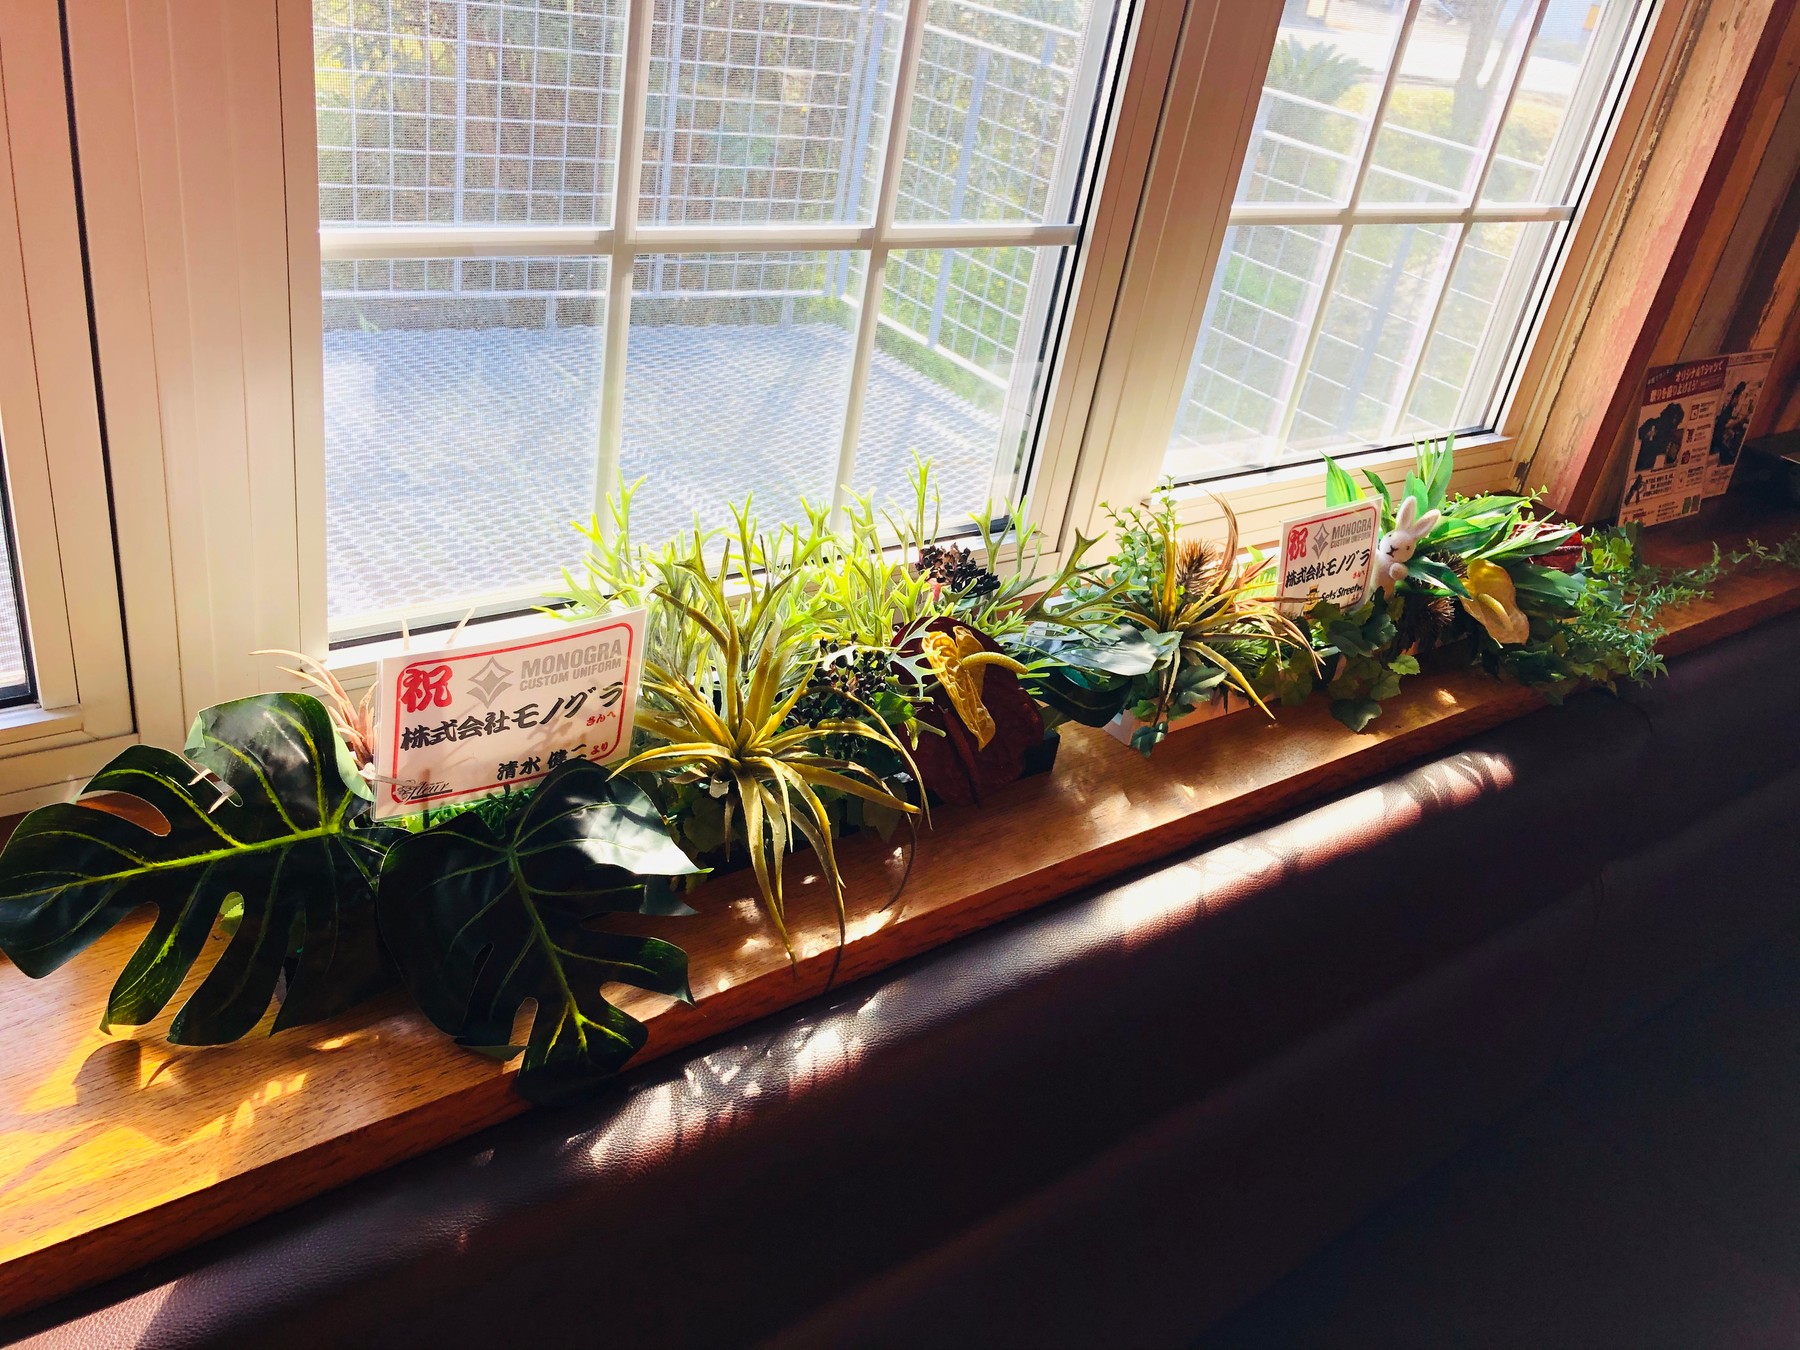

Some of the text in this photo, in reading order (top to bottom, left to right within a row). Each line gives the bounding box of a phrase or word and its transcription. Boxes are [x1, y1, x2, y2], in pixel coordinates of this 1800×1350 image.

[1288, 527, 1309, 561] 祝
[1332, 518, 1371, 540] MONOGRA
[1285, 549, 1370, 588] 株式会社モノグラ
[519, 657, 622, 692] CUSTOM UNIFORM
[520, 638, 622, 680] MONOGRA
[401, 665, 453, 713] 祝
[400, 681, 624, 751] 株式会社モノグラ
[586, 710, 616, 727] さんへ
